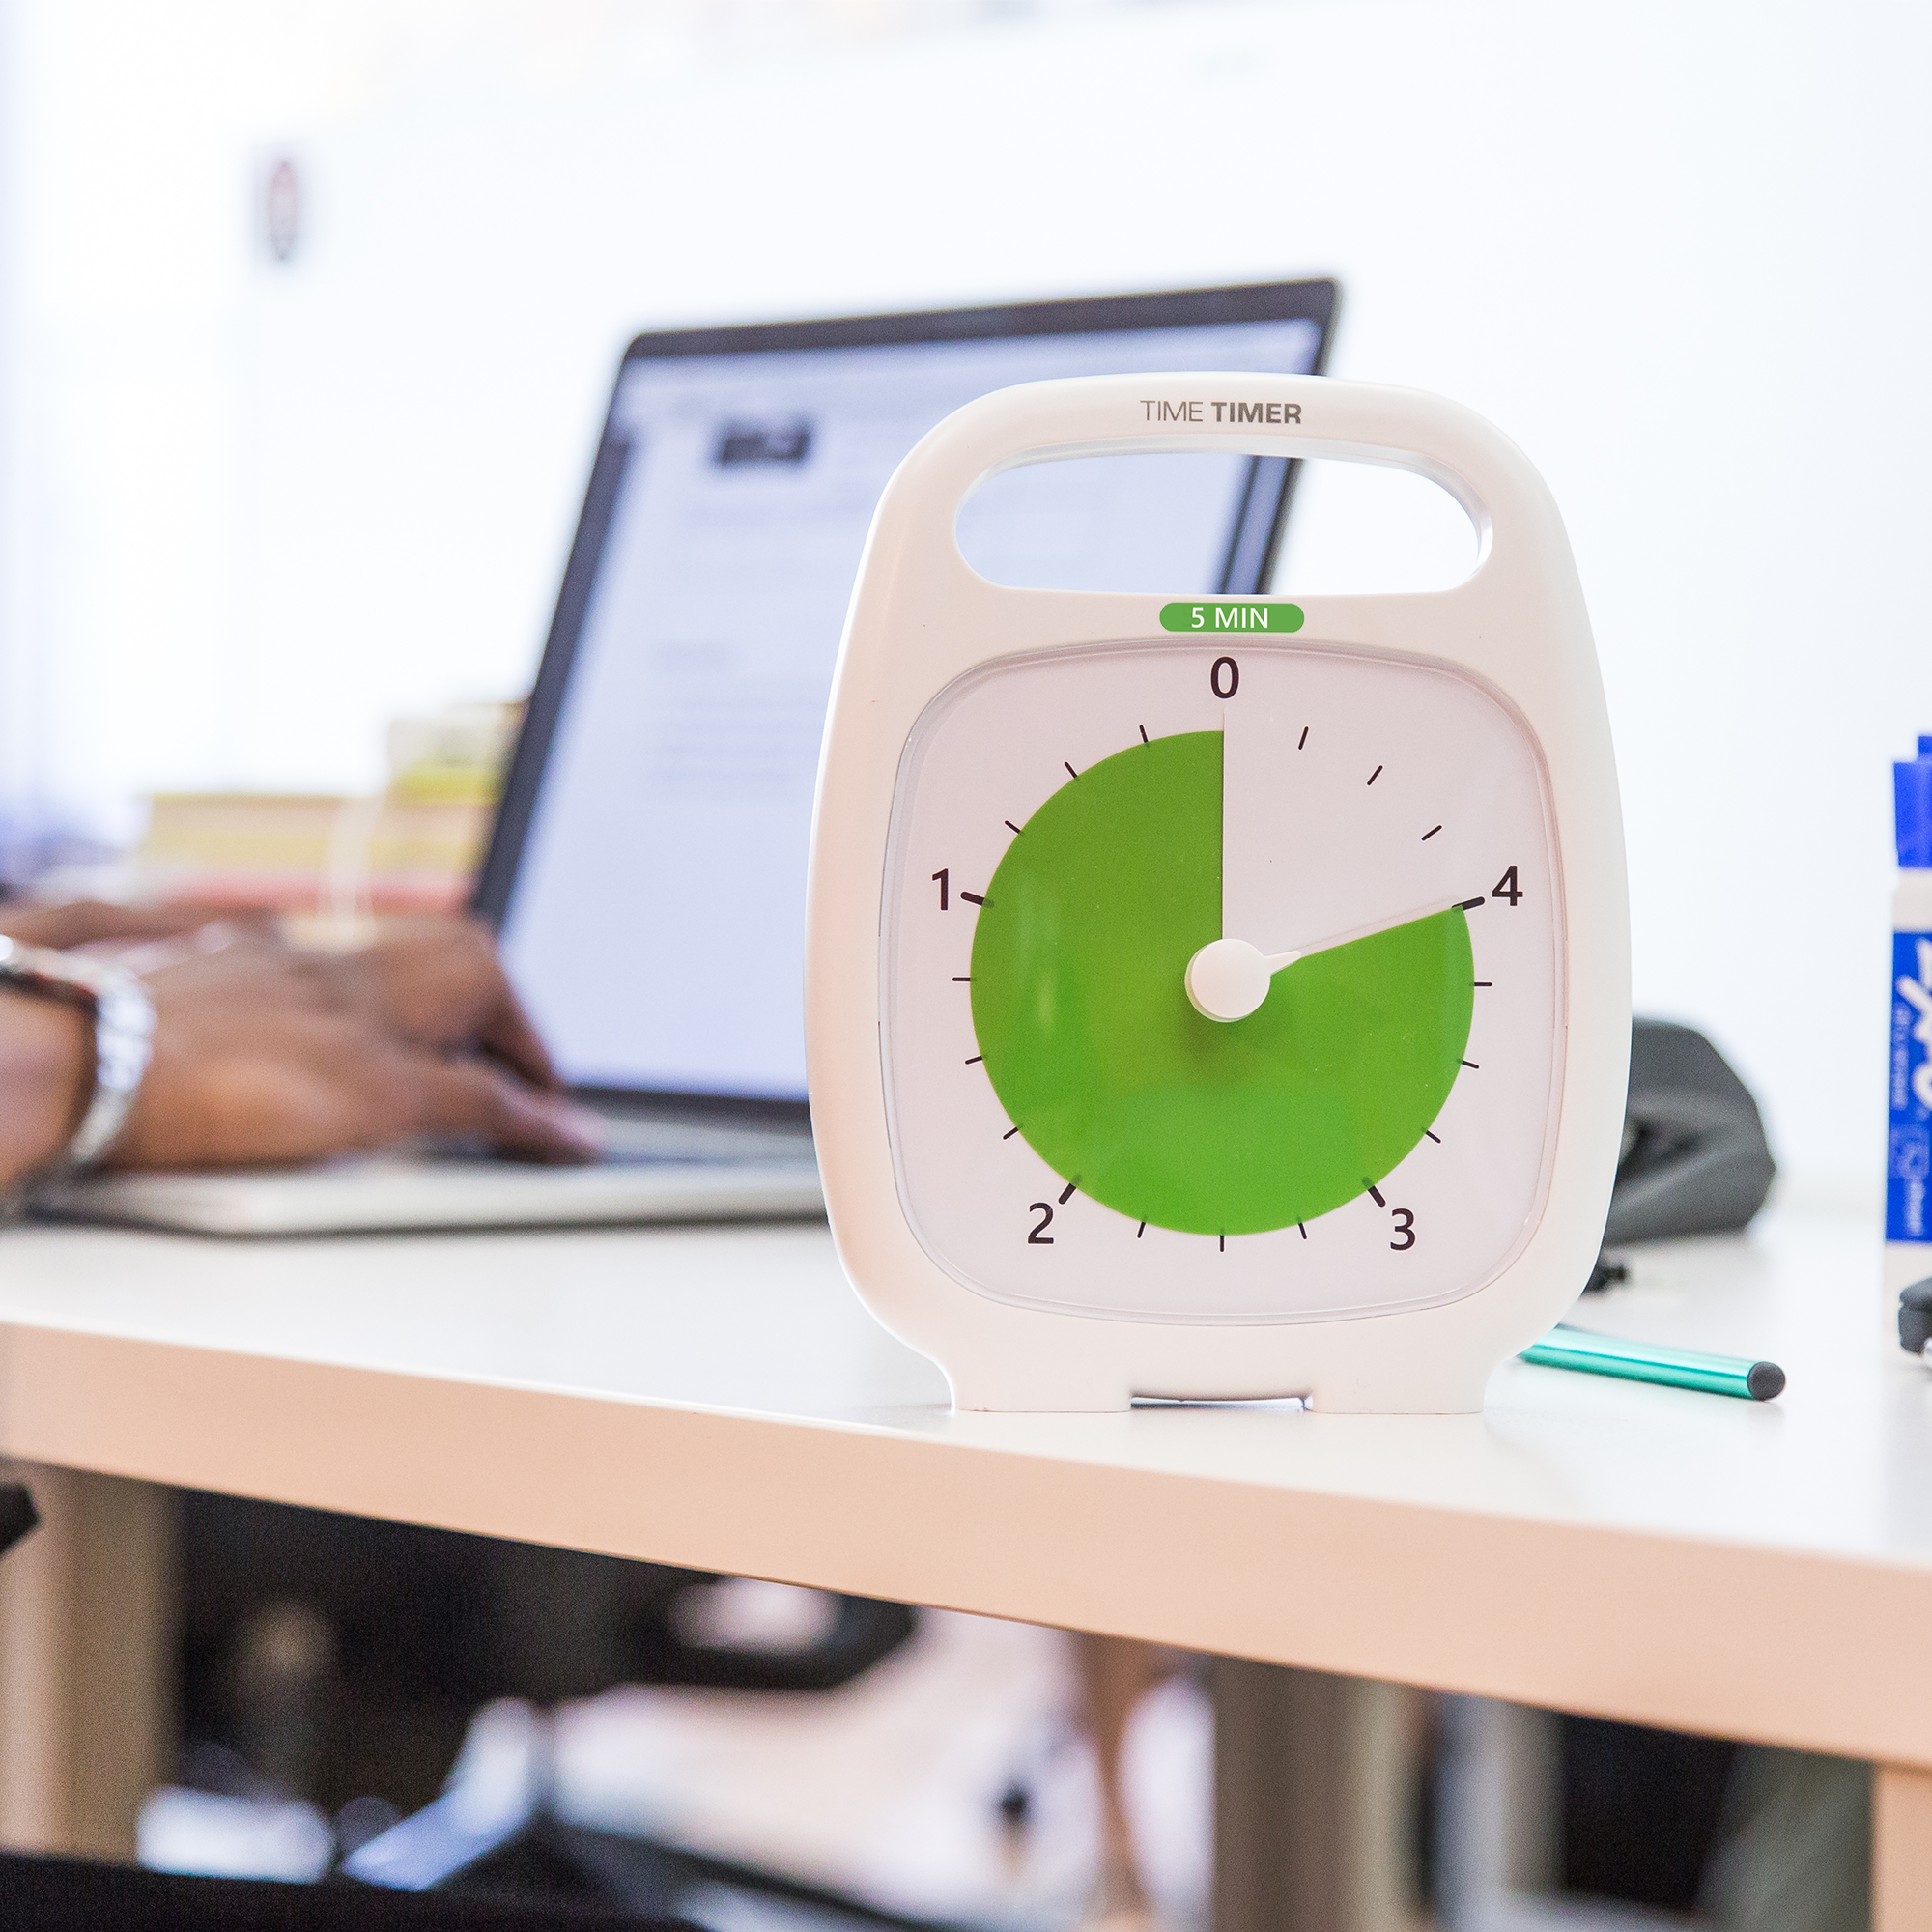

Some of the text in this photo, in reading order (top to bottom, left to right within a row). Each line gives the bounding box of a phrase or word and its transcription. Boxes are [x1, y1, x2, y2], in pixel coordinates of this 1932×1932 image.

[1140, 400, 1302, 424] TIME TIMER
[1191, 607, 1269, 629] 5 MIN
[1209, 656, 1240, 699] 0
[931, 868, 949, 911] 1
[1492, 866, 1523, 906] 4
[1027, 1202, 1055, 1245] 2
[1390, 1208, 1416, 1251] 3
